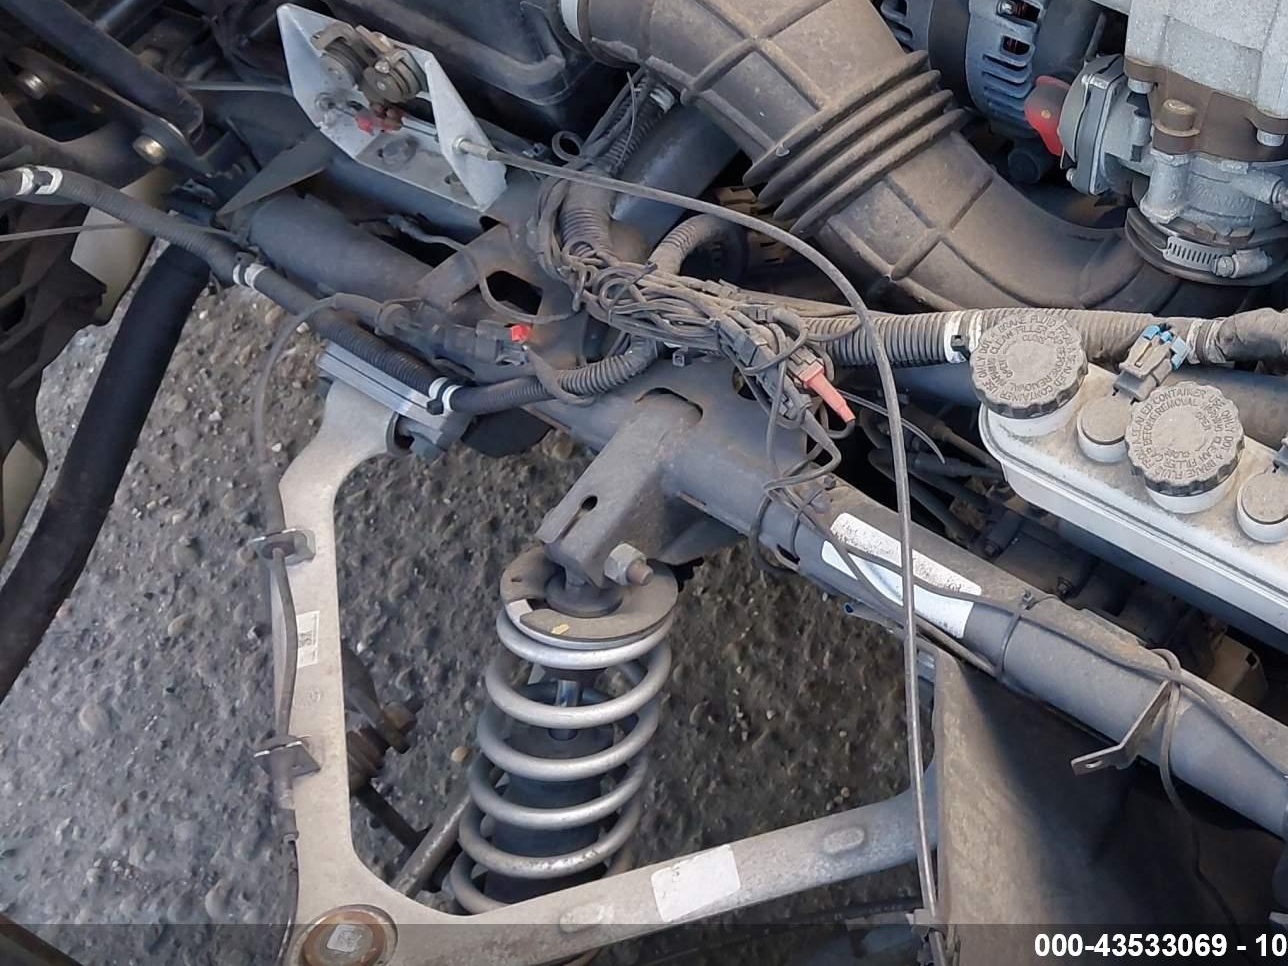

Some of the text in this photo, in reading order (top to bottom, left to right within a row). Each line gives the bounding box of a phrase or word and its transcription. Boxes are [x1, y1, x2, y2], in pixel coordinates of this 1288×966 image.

[1030, 315, 1057, 327] FLUID
[1000, 386, 1054, 402] CONTAINER
[1152, 388, 1207, 405] CONTAINER
